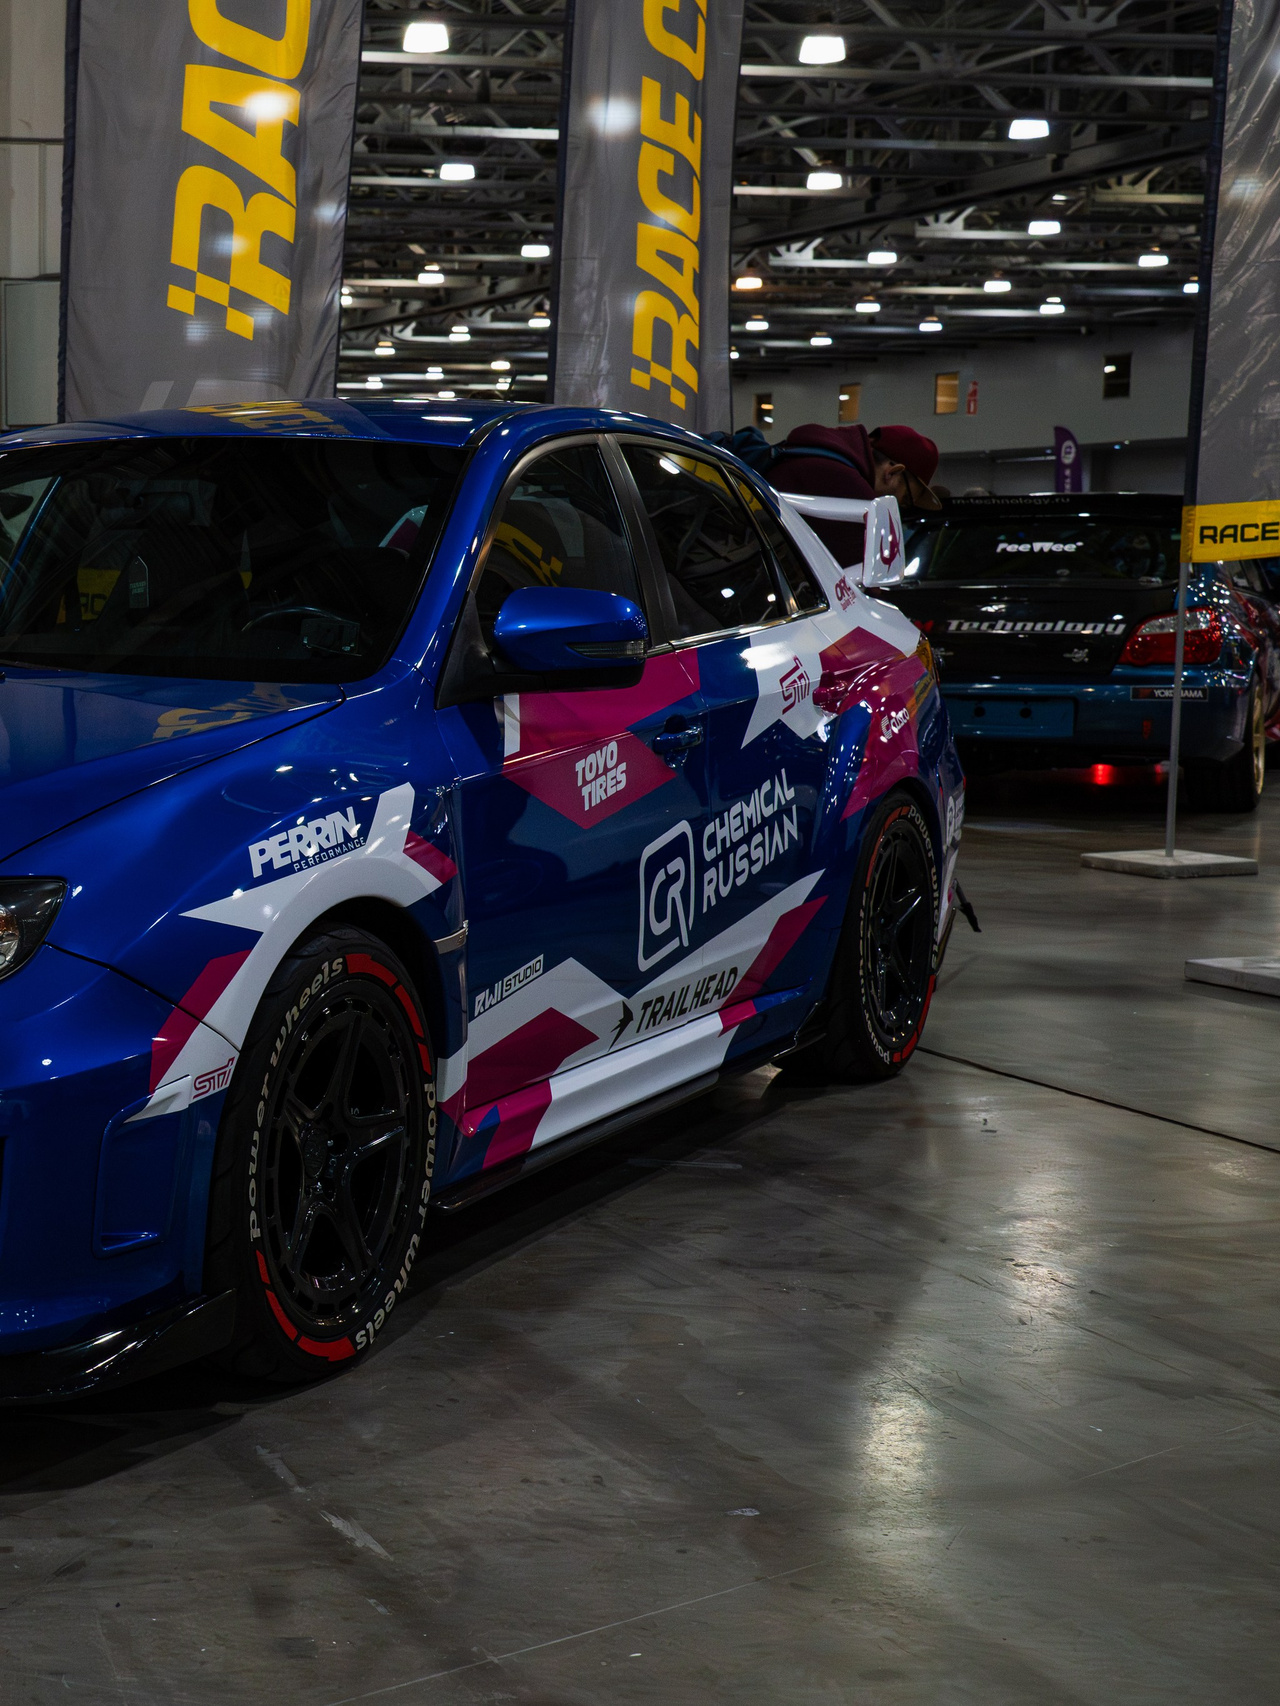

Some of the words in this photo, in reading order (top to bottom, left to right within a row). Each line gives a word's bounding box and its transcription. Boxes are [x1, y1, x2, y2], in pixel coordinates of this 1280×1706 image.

[630, 75, 702, 411] RACE
[1199, 521, 1280, 544] RACE
[948, 619, 1127, 636] Technology
[575, 740, 618, 787] TOYO
[581, 761, 627, 812] TIRES
[248, 806, 359, 879] PERRIN
[702, 767, 795, 862] CHEMICAL
[293, 836, 366, 872] PERFORMANCE
[702, 804, 798, 914] RUSSIAN
[504, 958, 543, 993] STUDIO
[635, 966, 739, 1034] TRAILHEAD
[248, 1073, 271, 1243] power
[272, 956, 344, 1068] wheels
[422, 1082, 438, 1230] power
[355, 1231, 421, 1352] wheels
